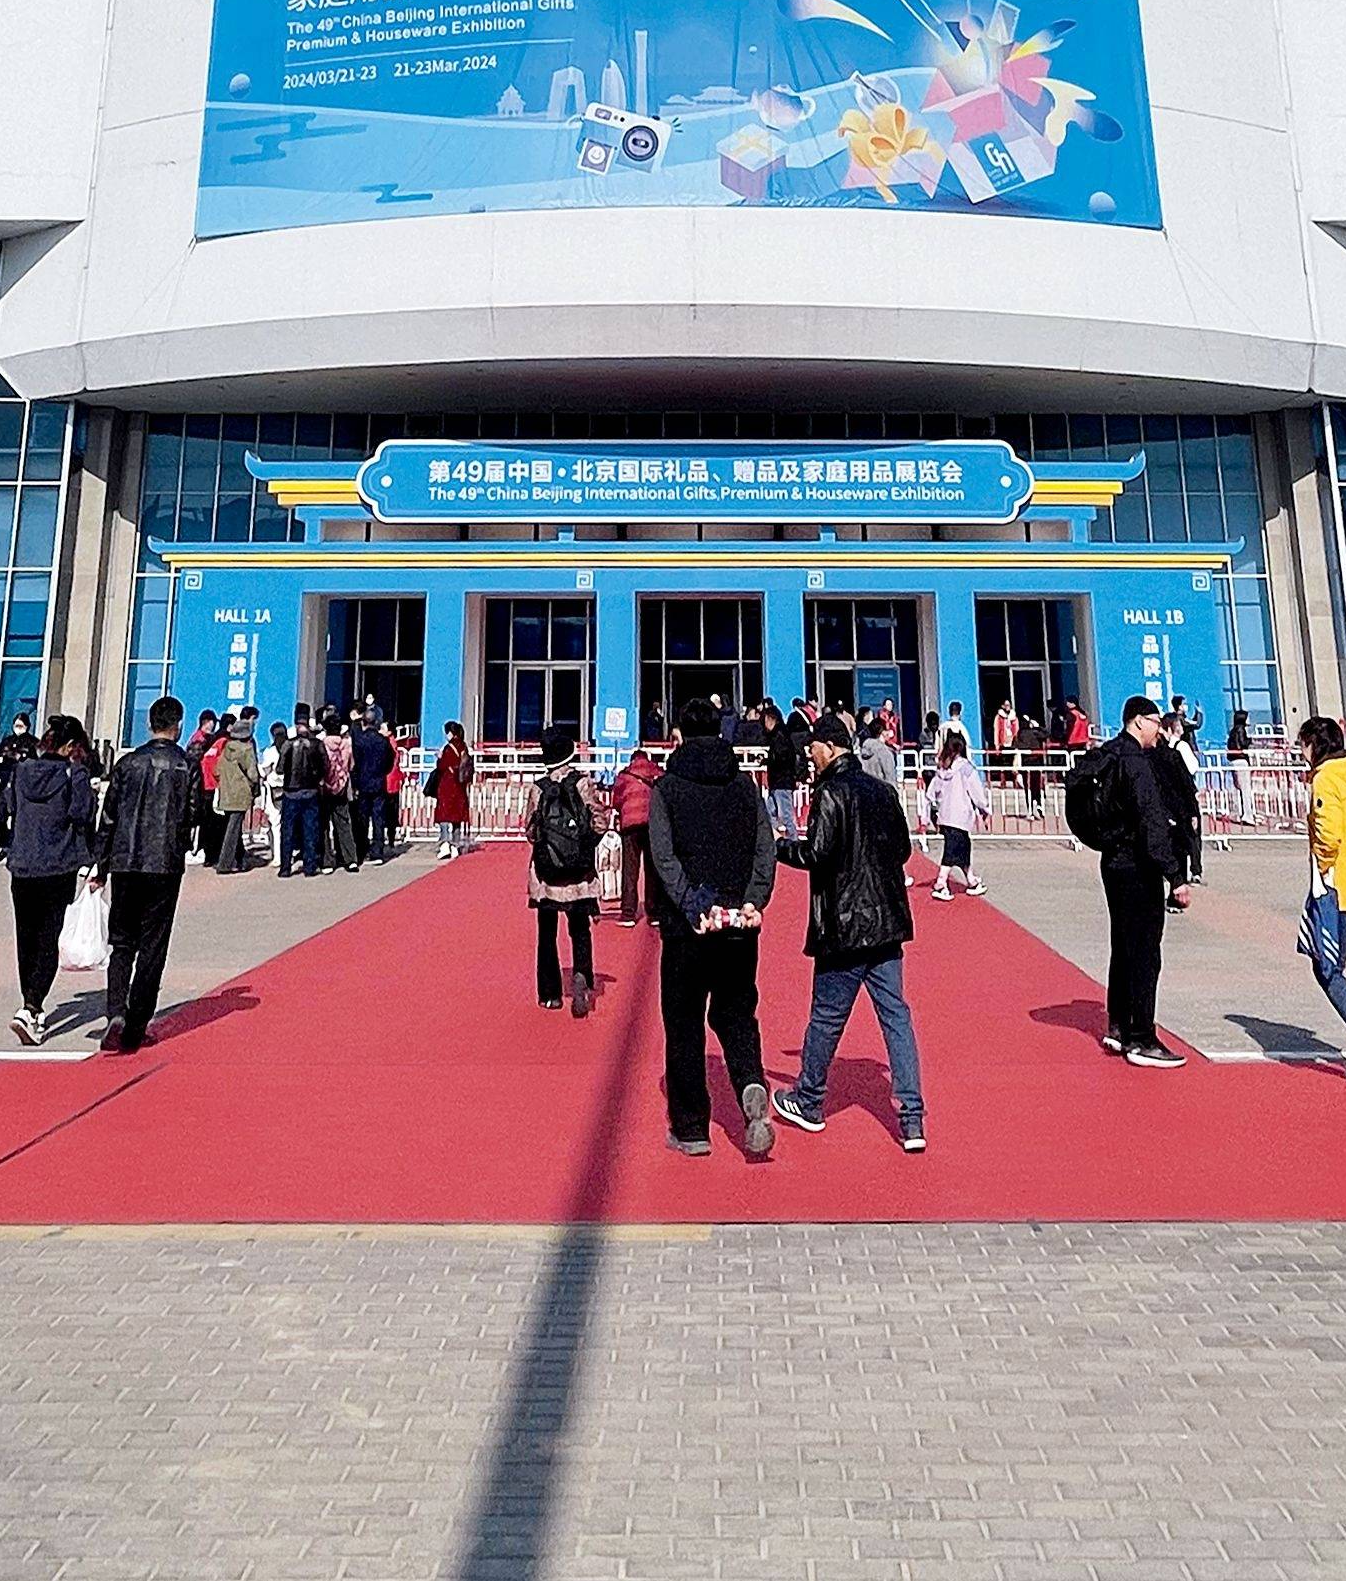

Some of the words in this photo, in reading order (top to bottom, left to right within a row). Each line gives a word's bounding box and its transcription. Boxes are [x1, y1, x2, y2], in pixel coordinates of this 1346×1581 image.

[287, 22, 313, 35] The
[342, 12, 381, 29] China
[385, 7, 435, 26] Beijing
[439, 0, 533, 19] International
[285, 35, 348, 52] Premium
[351, 31, 362, 44] &
[365, 24, 447, 43] Houseware
[451, 16, 526, 35] Exhibition
[283, 64, 378, 90] 2024/03/21-23
[428, 486, 455, 501] The
[486, 486, 529, 501] China
[532, 486, 583, 504] Beijing
[585, 486, 680, 501] International
[791, 486, 803, 501] &
[805, 486, 889, 501] Houseware
[891, 486, 965, 501] Exhibition
[214, 608, 249, 624] HALL
[254, 608, 271, 624] 1A
[1123, 608, 1162, 625] HALL
[1165, 608, 1184, 625] 1B
